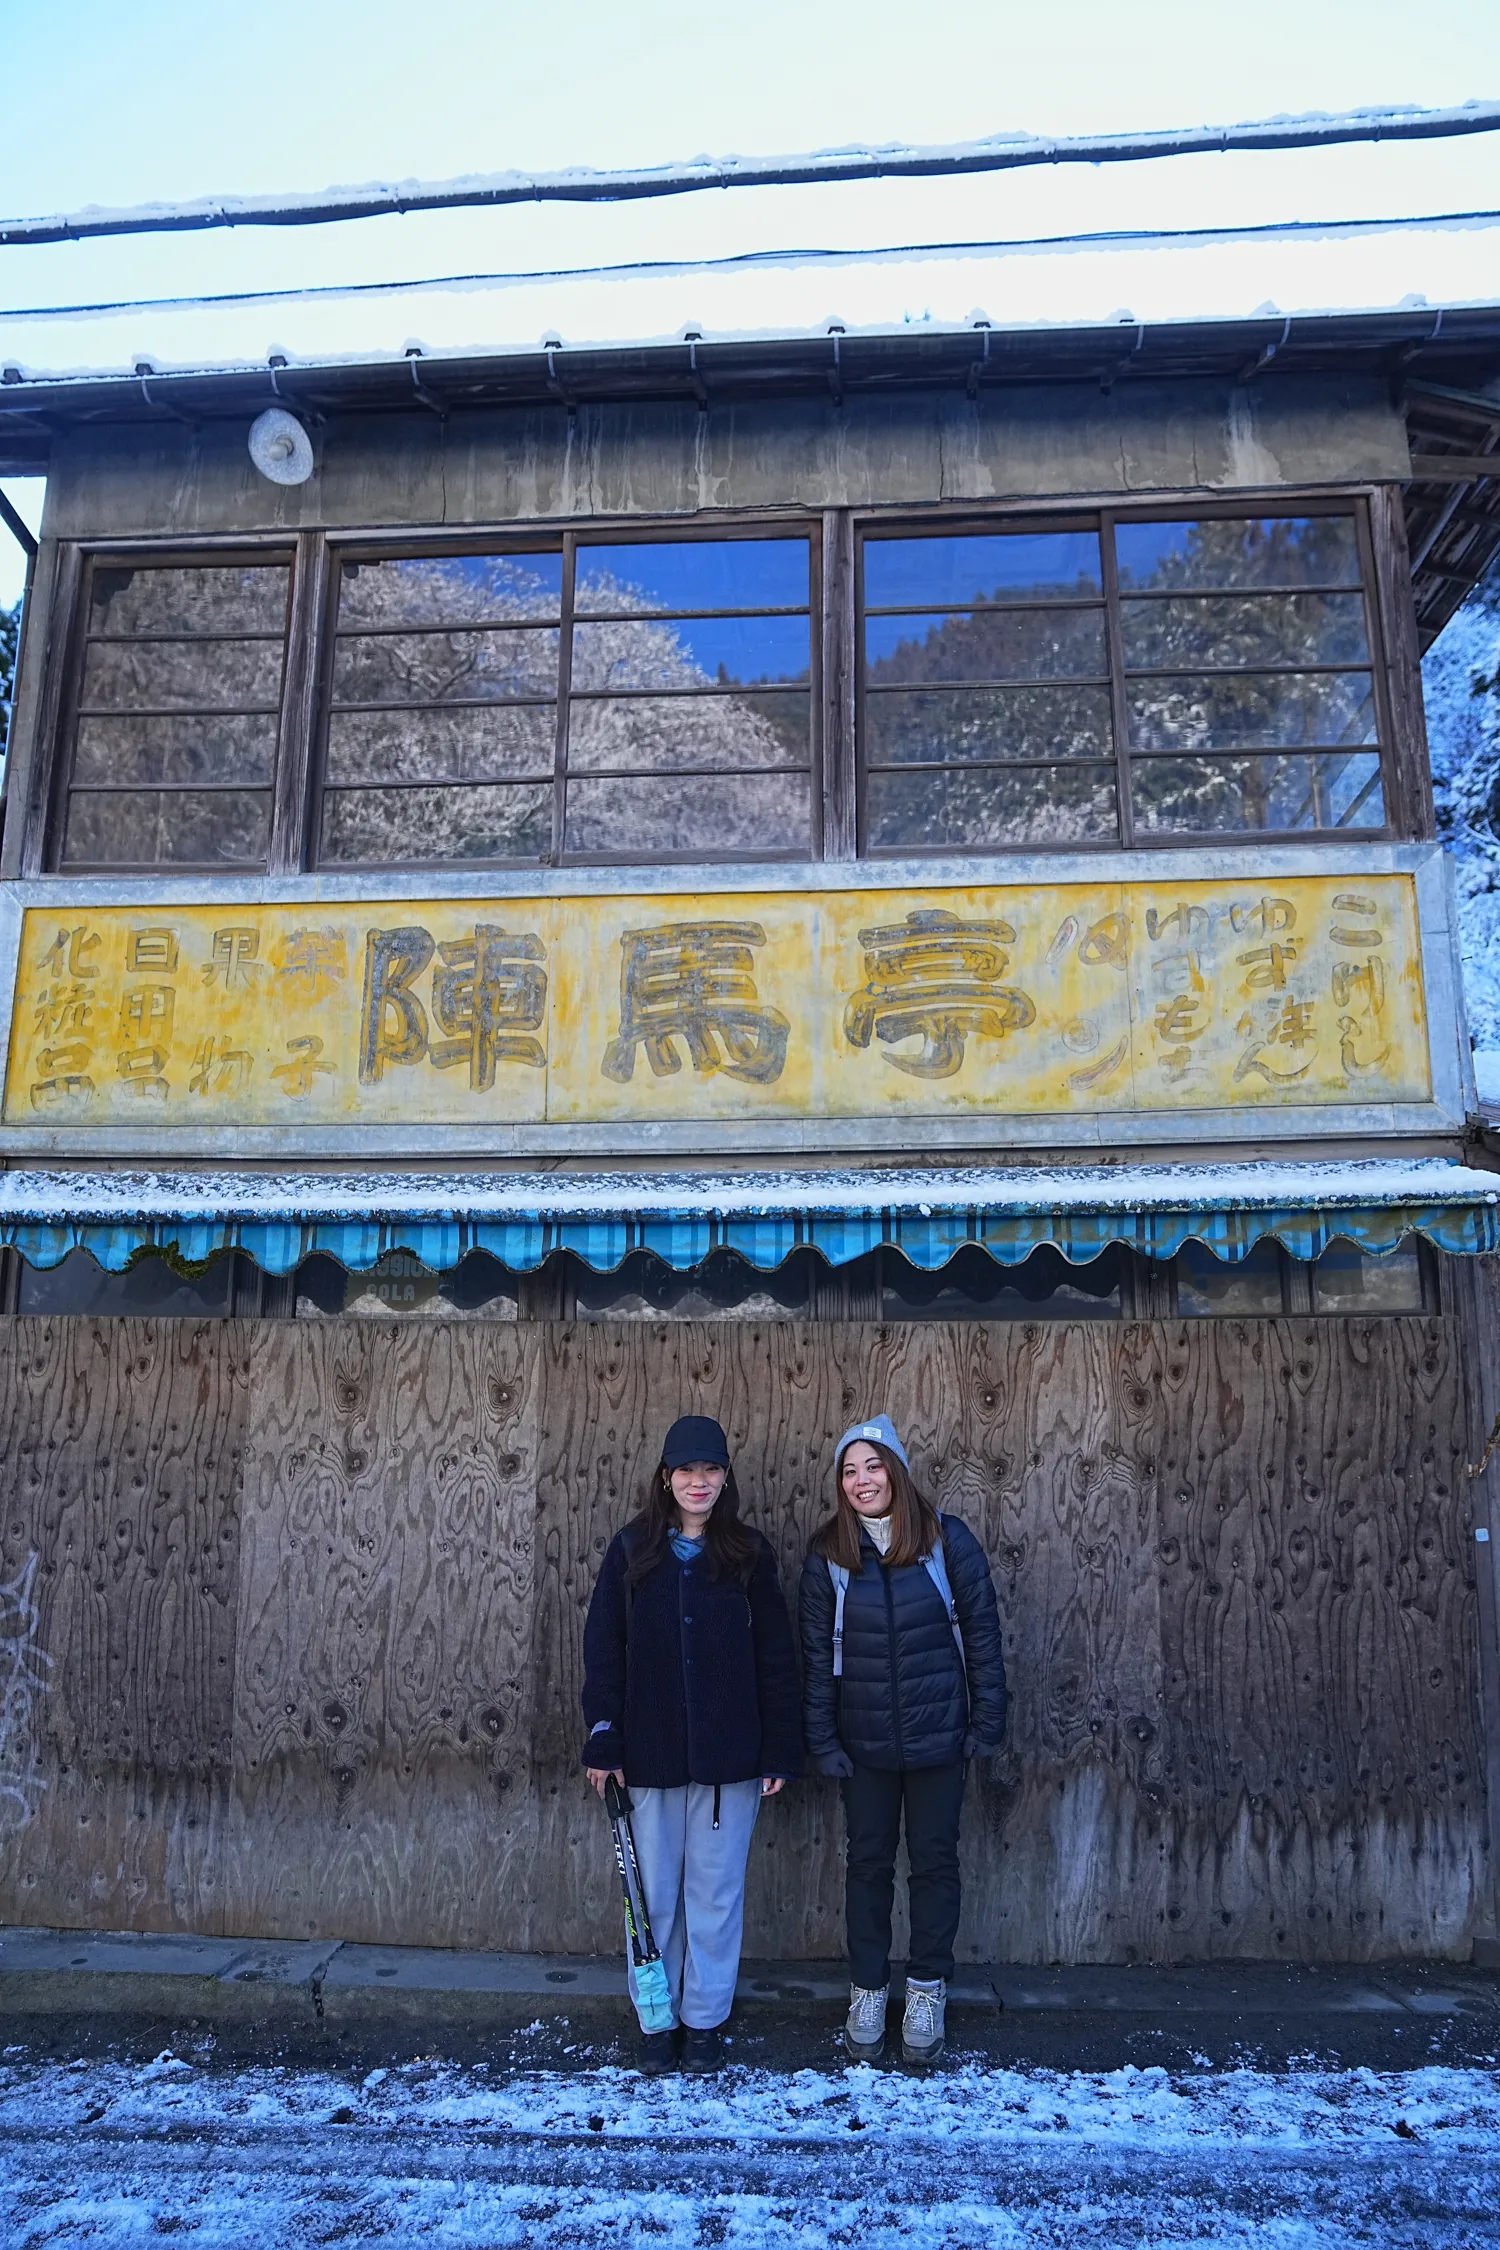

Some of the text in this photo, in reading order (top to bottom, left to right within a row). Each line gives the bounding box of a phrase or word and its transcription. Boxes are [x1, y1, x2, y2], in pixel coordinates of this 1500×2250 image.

[110, 927, 181, 1108] 日用品
[188, 927, 264, 1097] 果物
[614, 1843, 626, 1875] LEKI
